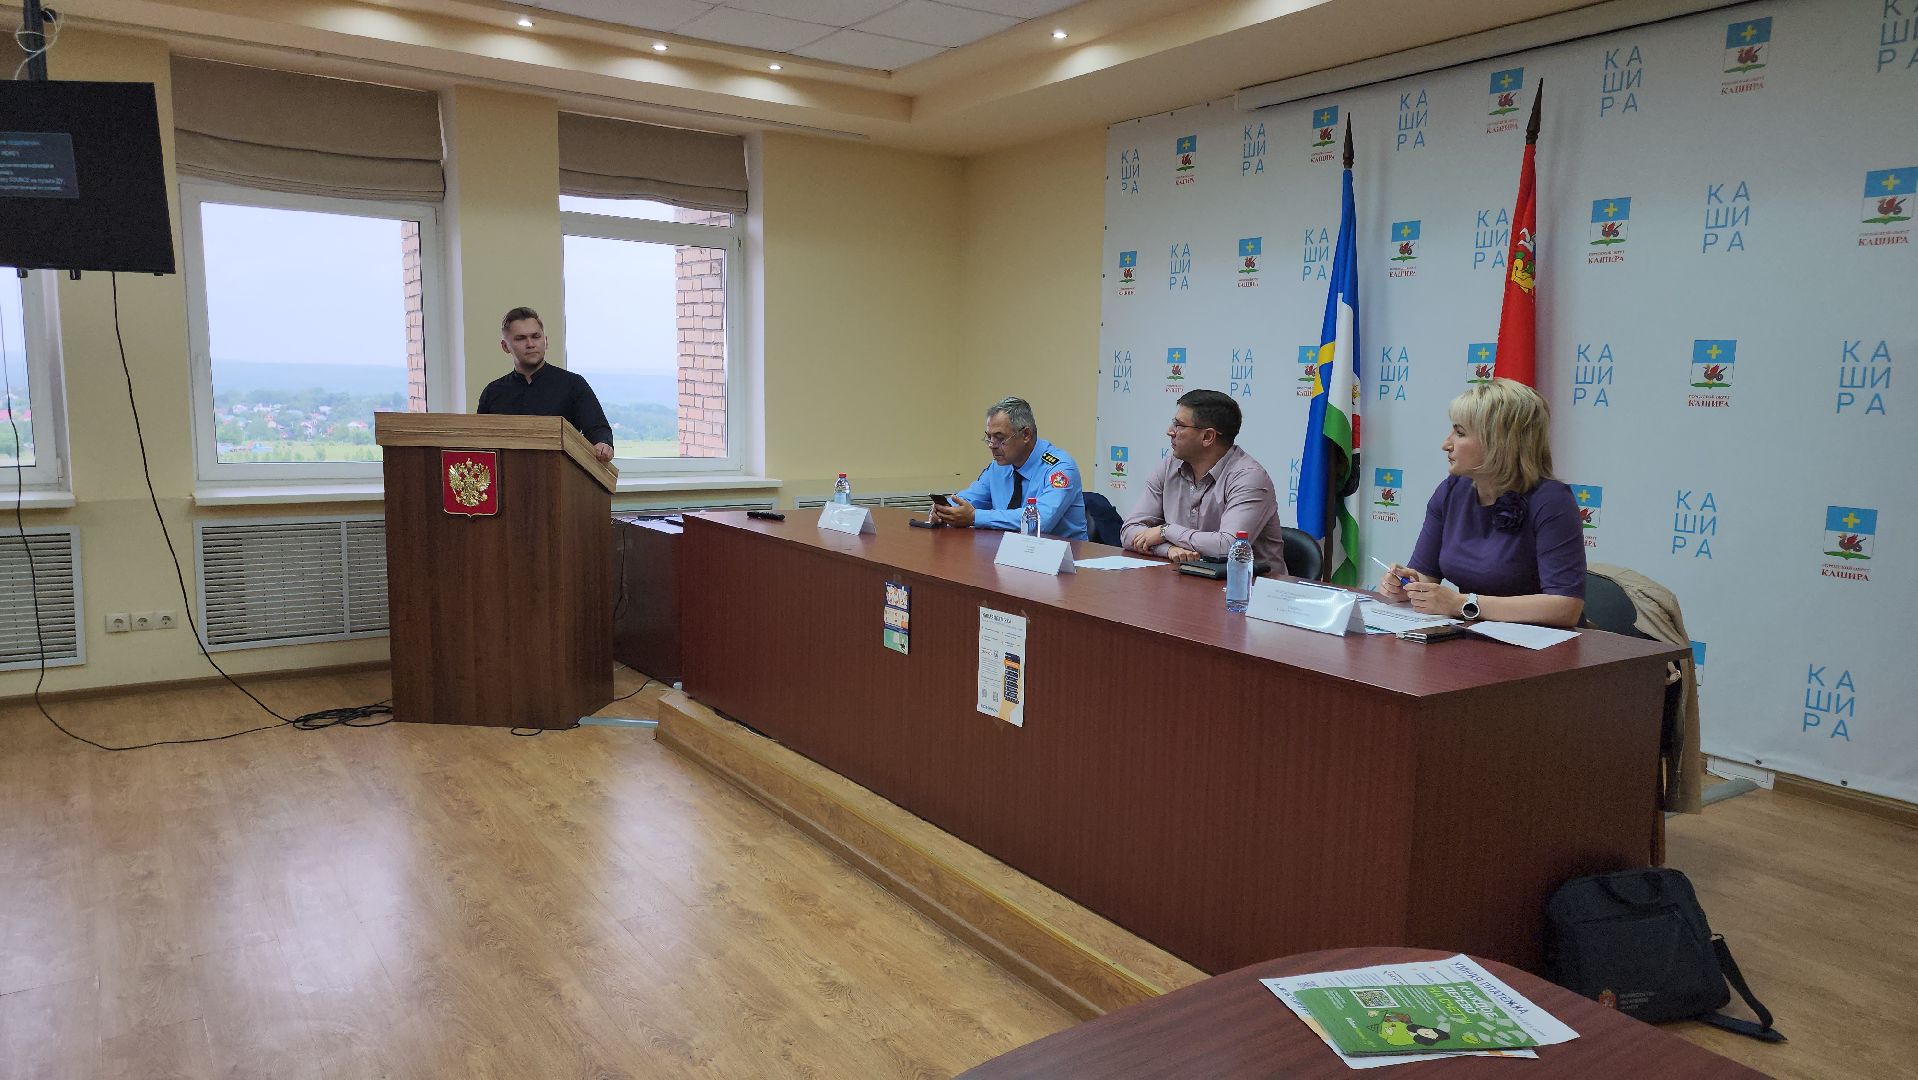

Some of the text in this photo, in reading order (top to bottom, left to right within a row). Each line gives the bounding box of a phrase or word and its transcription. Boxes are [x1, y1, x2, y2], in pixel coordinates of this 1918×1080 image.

[1858, 236, 1909, 247] КАШИРА
[1688, 400, 1730, 408] КАШИРА
[1821, 568, 1870, 582] КАШИРА
[1454, 961, 1483, 983] УМНАЯ
[1479, 981, 1529, 1015] ПЛАТЕЖКА
